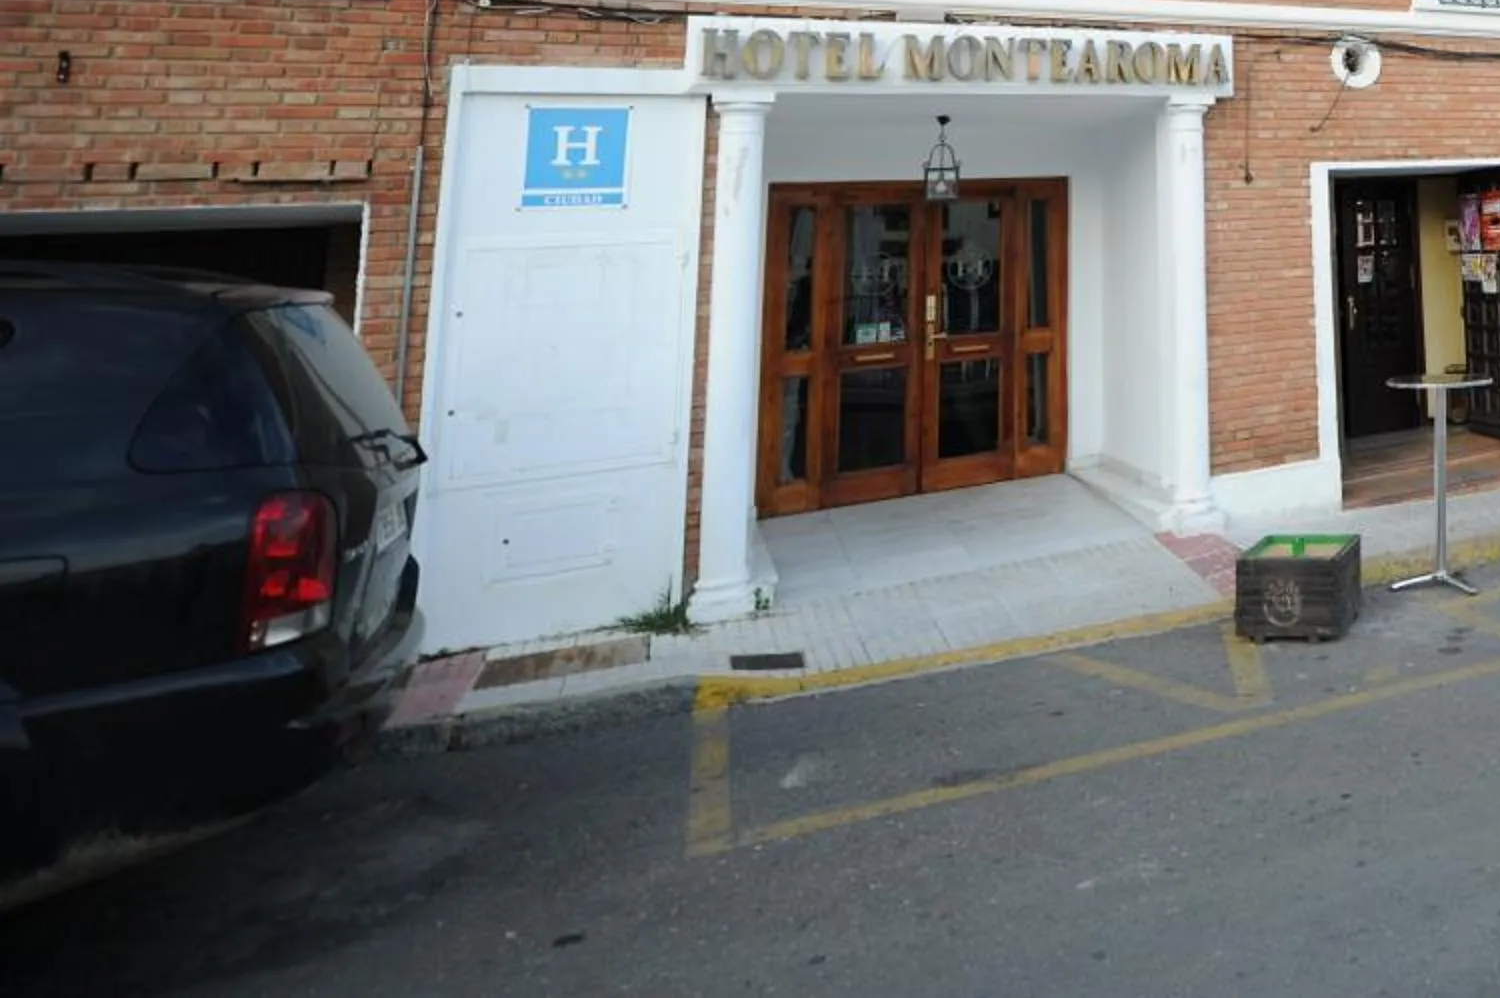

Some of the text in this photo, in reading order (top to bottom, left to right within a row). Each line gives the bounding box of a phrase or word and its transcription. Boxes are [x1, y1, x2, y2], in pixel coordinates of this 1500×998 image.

[701, 27, 1230, 86] HOTEL MONTEAROMA
[549, 124, 604, 167] H
